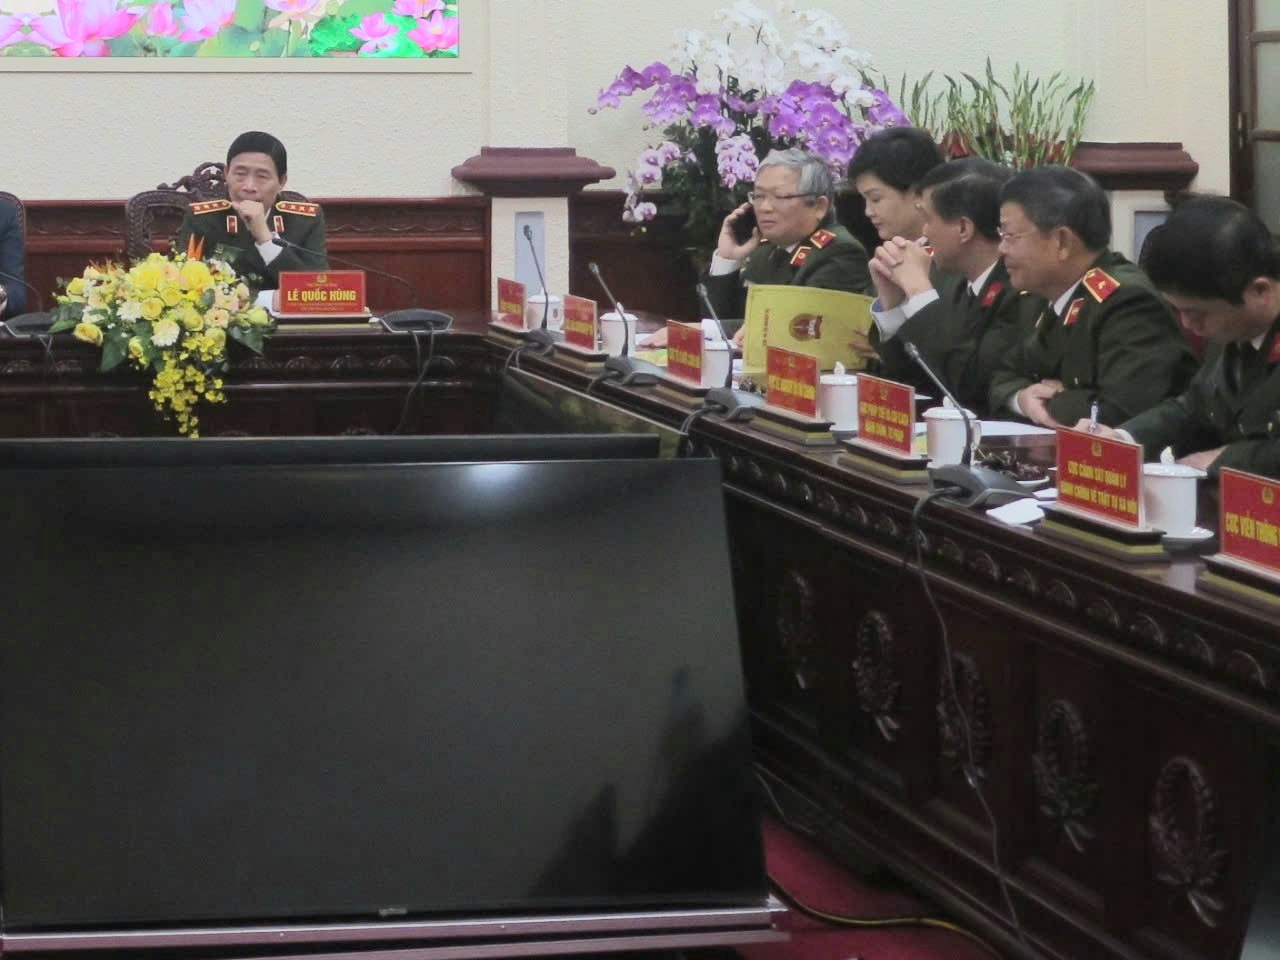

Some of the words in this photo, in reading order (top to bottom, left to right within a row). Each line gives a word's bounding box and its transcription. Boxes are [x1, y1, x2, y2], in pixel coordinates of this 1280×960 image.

[287, 288, 299, 302] LÊ
[301, 286, 327, 302] QUỐC
[329, 288, 357, 302] HÙNG
